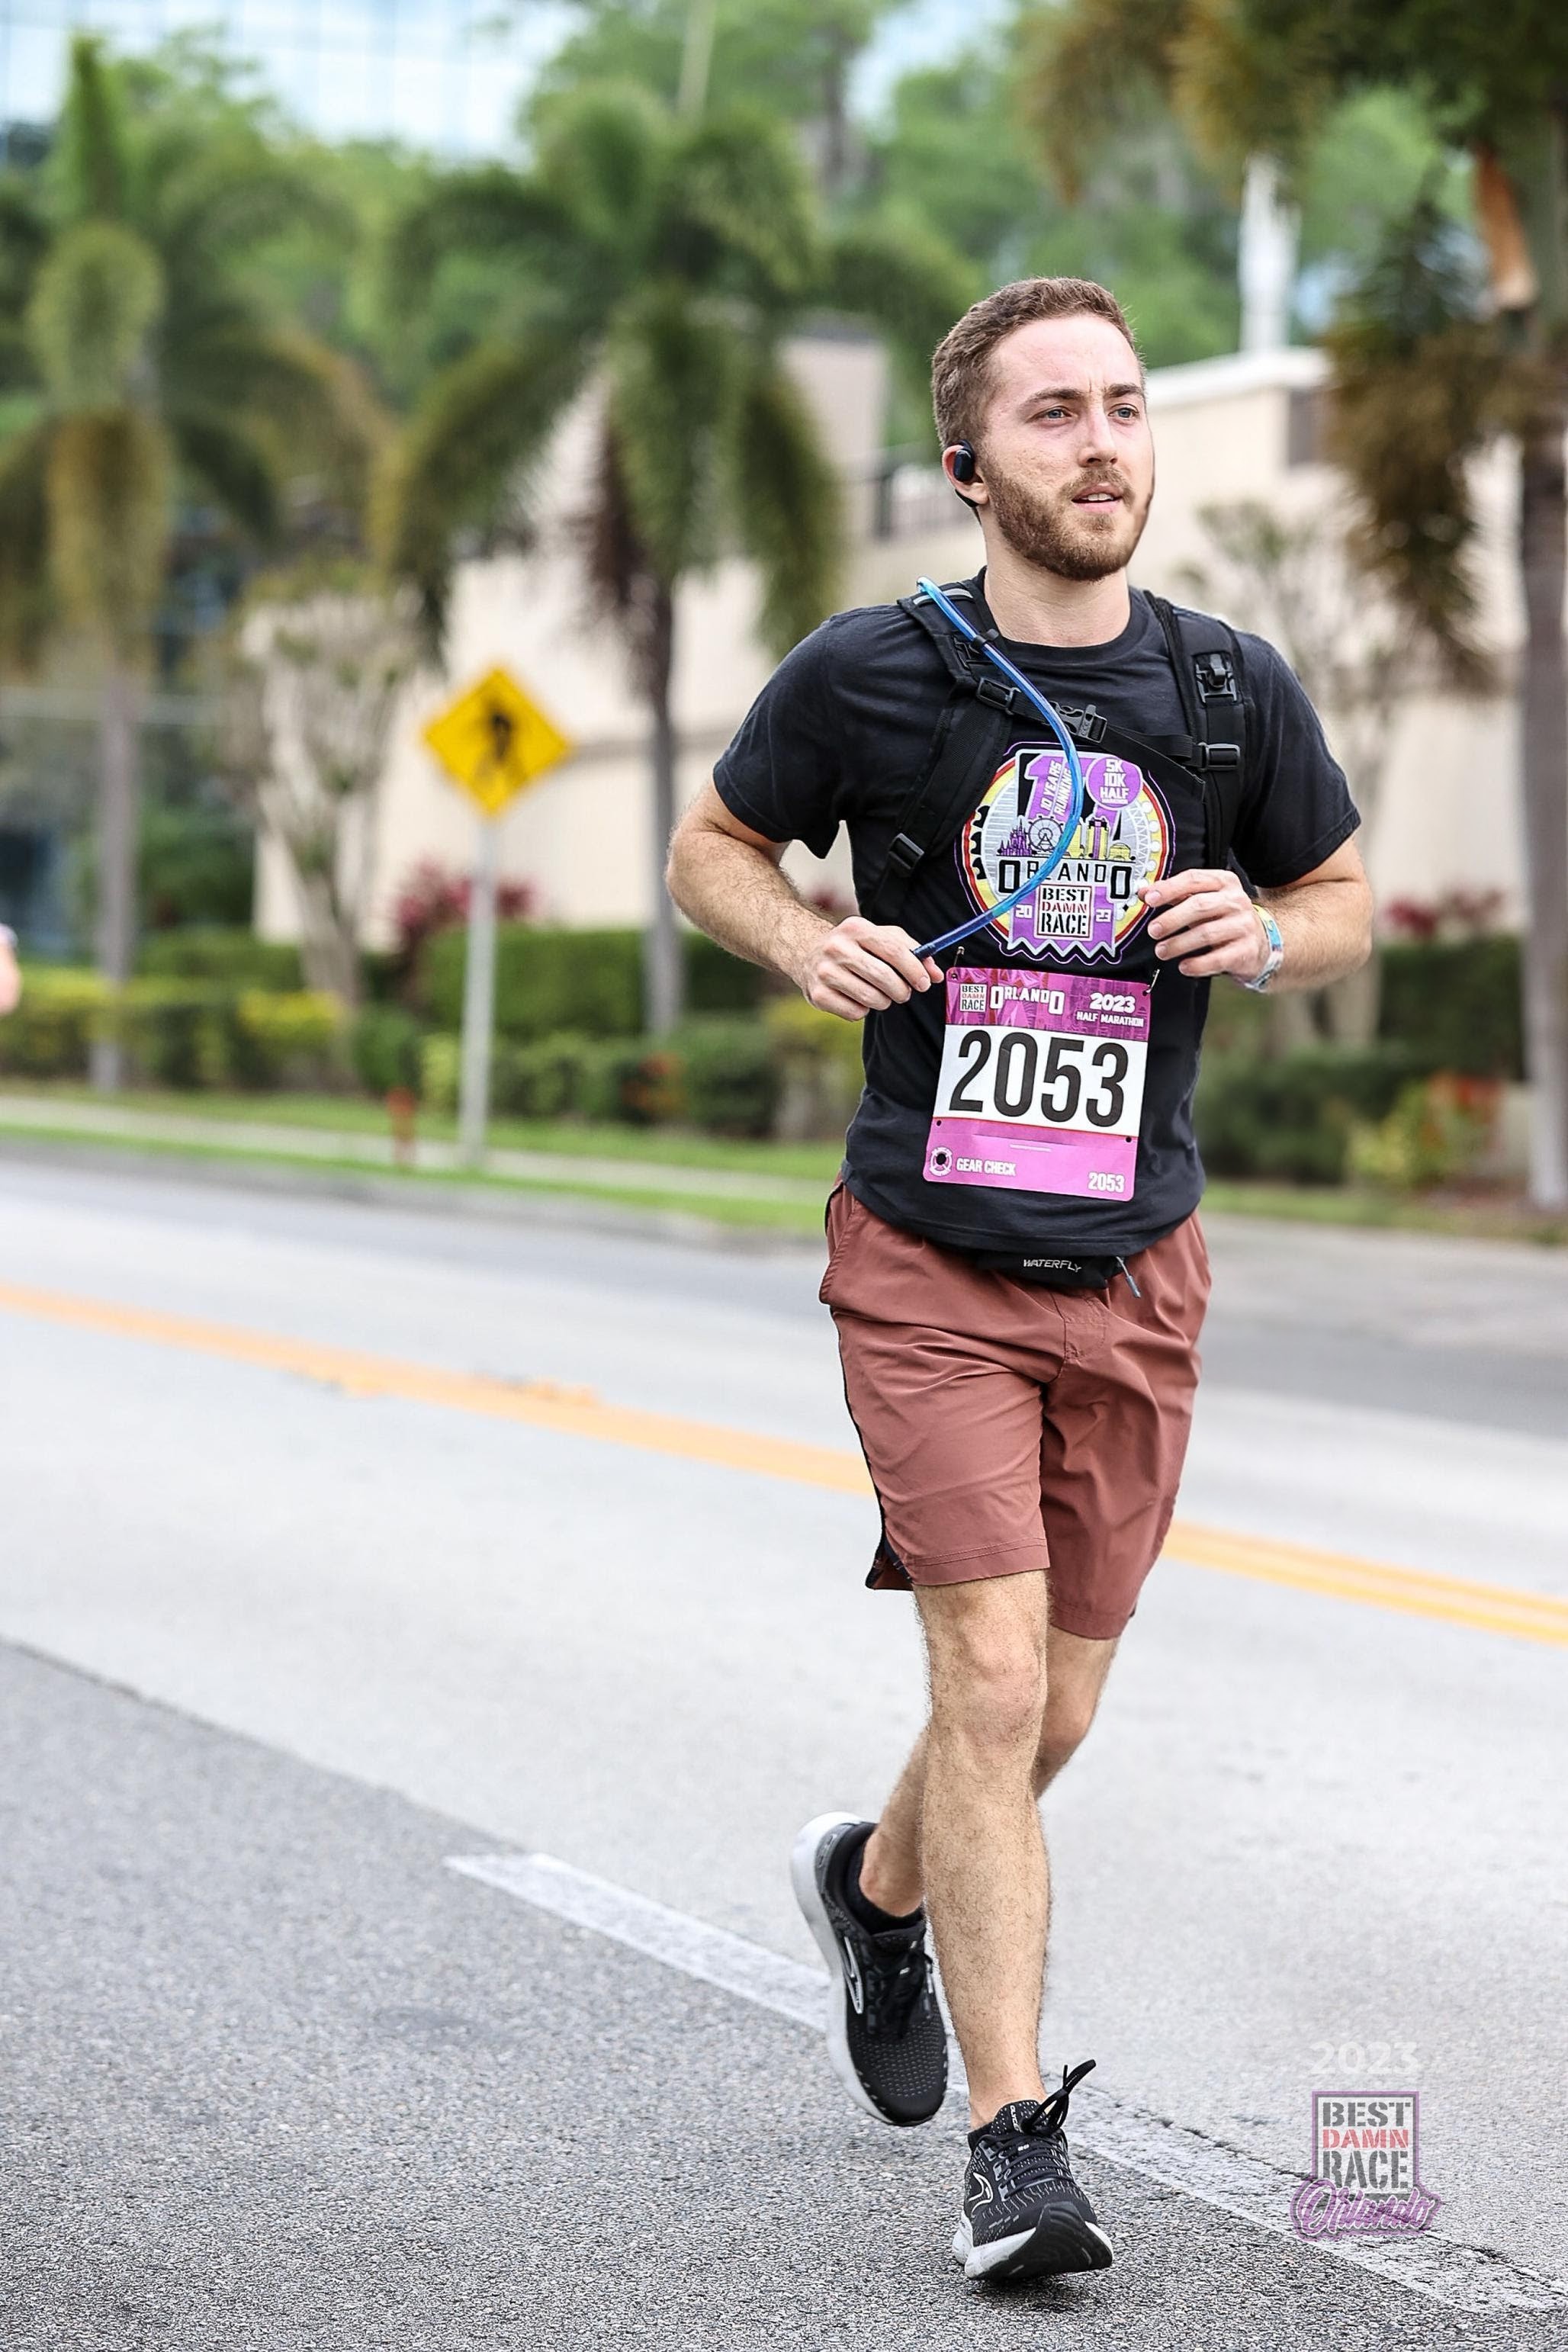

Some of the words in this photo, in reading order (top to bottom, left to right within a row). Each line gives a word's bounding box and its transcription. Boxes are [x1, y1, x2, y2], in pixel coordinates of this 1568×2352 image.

[1106, 759, 1125, 772] 5K
[1043, 760, 1062, 796] YEARS
[1103, 773, 1126, 787] 10K
[1100, 786, 1129, 798] HALF
[1040, 797, 1053, 811] 10
[998, 860, 1133, 899] ORANDO
[1042, 888, 1088, 902] BEST
[1016, 904, 1033, 919] 20
[1041, 901, 1087, 914] DAMN
[1040, 913, 1087, 935] RACE
[961, 999, 985, 1011] RACE
[990, 985, 1065, 1015] ORLANDO
[1089, 992, 1136, 1014] 2023
[1076, 1011, 1098, 1023] HALF
[1100, 1013, 1144, 1027] MARATHON
[949, 1030, 1129, 1127] 2053
[956, 1158, 982, 1173] GEAR
[984, 1160, 1017, 1176] CHECK
[1088, 1171, 1125, 1193] 2053
[1023, 1258, 1082, 1273] WATERFLY
